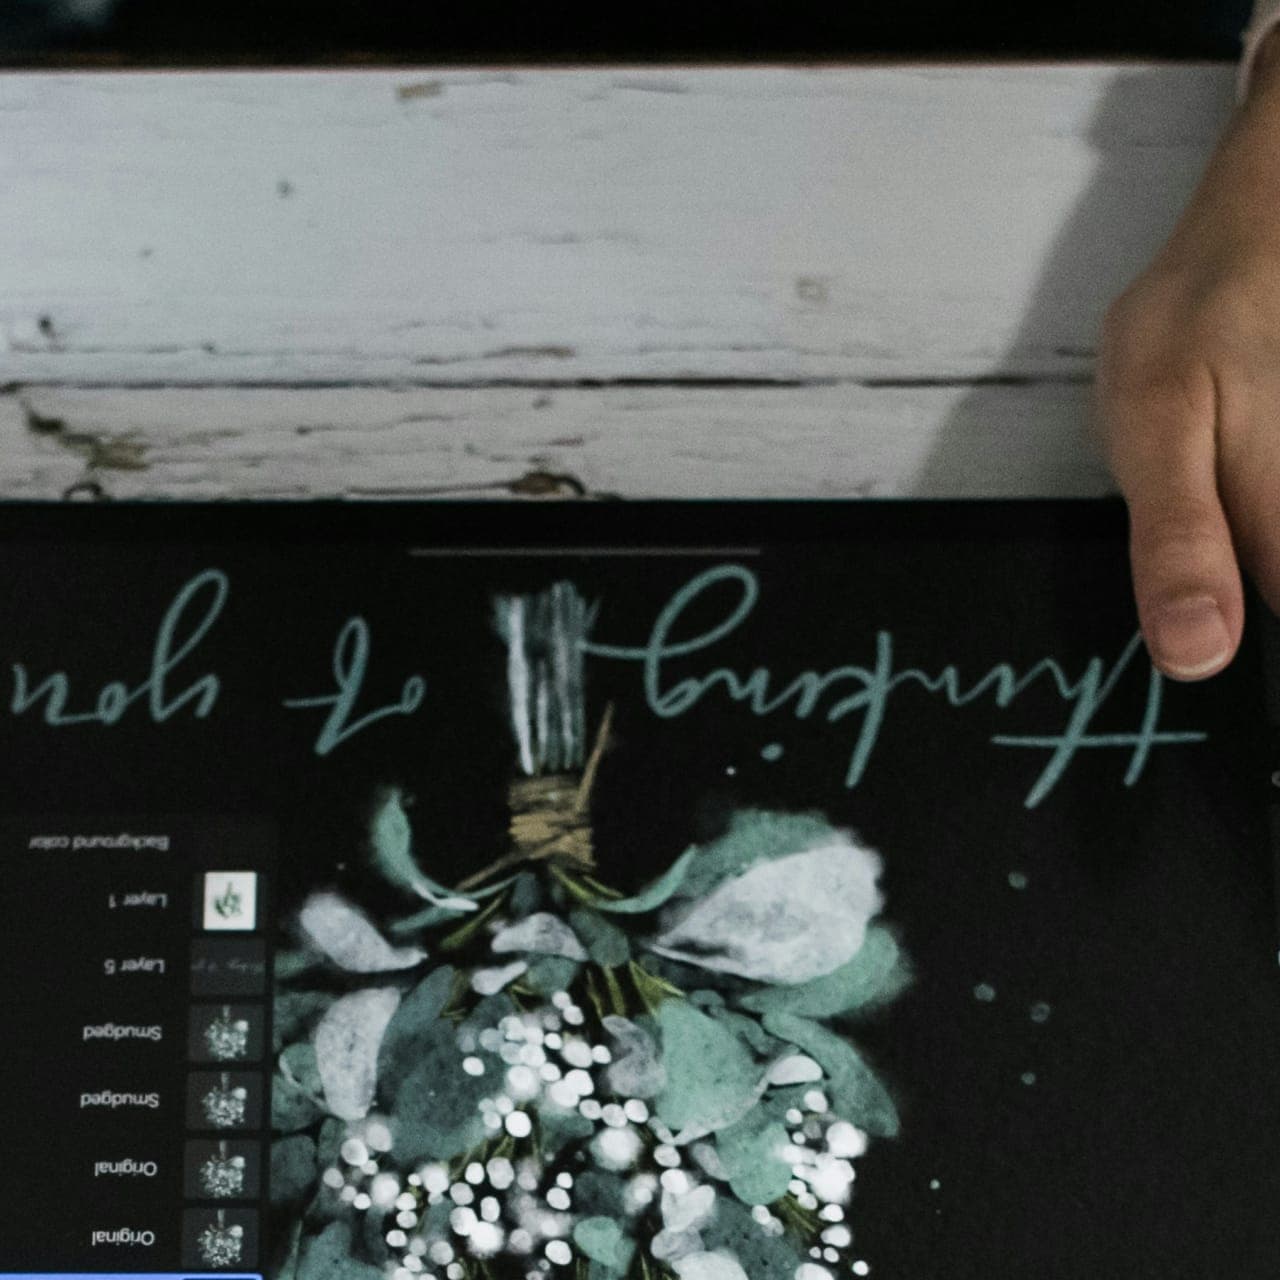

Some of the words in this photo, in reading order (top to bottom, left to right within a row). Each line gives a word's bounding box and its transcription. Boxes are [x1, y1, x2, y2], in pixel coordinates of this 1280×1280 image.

[11, 568, 230, 734] you
[284, 617, 426, 758] of
[574, 563, 1208, 808] thinking
[29, 836, 70, 850] color
[72, 833, 170, 851] Background
[108, 894, 117, 909] 1
[123, 891, 168, 908] Layer
[103, 959, 116, 975] 5
[120, 956, 165, 974] Layer
[82, 1022, 163, 1041] Smudged
[80, 1090, 160, 1109] Smudged
[94, 1158, 158, 1177] Original
[91, 1227, 156, 1247] Original
